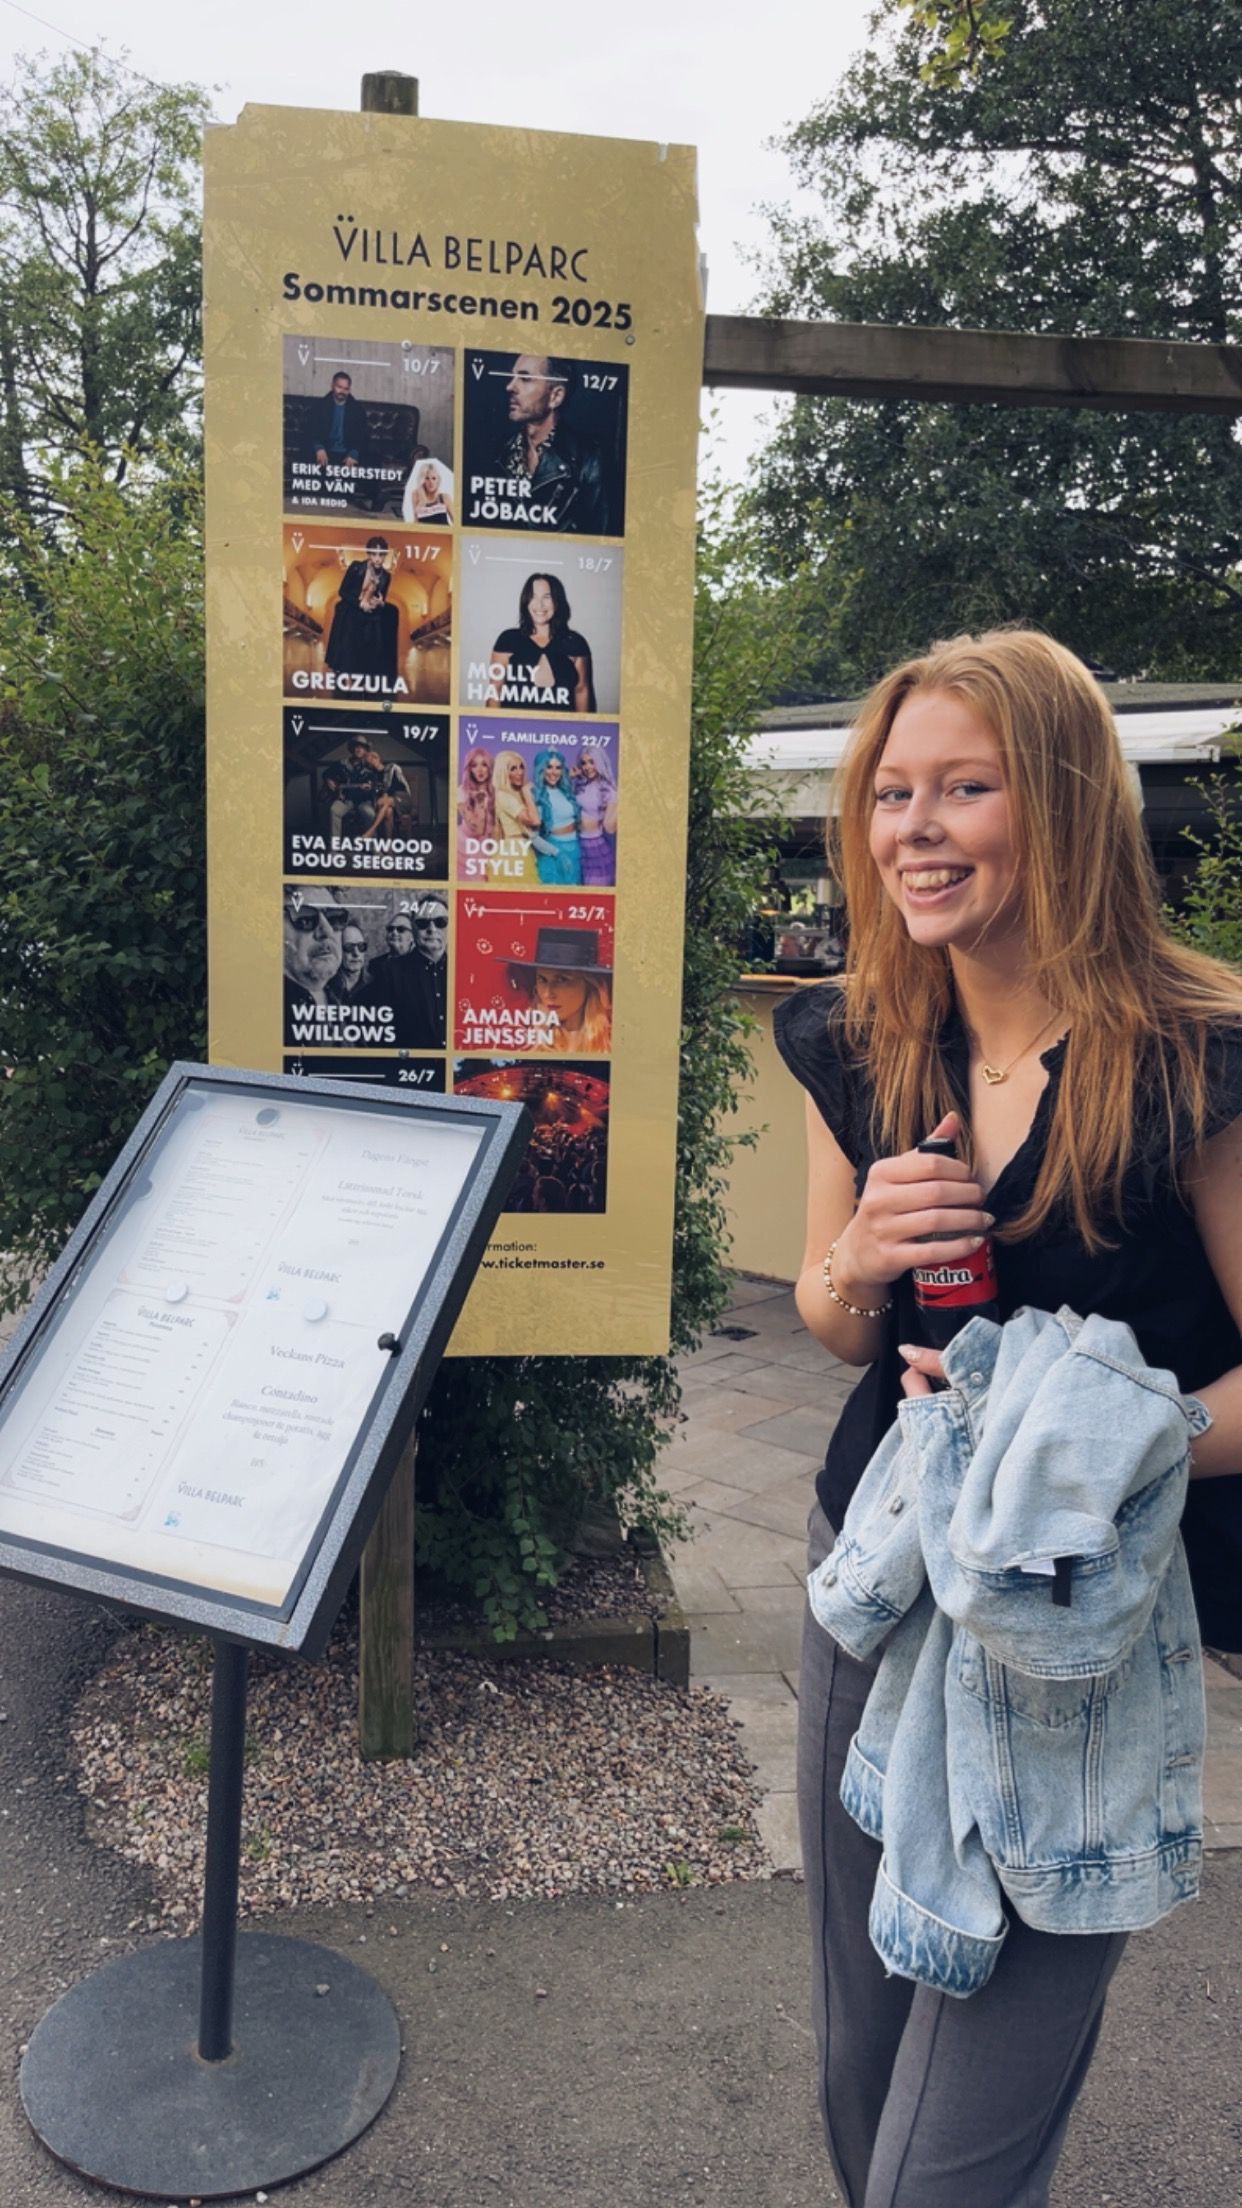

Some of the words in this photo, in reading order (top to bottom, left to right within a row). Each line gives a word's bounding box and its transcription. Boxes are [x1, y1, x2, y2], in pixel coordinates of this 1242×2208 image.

[445, 235, 588, 283] BELPARC
[282, 272, 539, 322] Sommarscenen
[551, 296, 632, 331] 2025
[402, 357, 440, 376] 10/7
[582, 373, 618, 392] 12/7
[292, 463, 322, 476] ERIK
[326, 465, 404, 482] SEGERSTEDT
[292, 479, 322, 492] MED
[325, 479, 355, 494] VÄN
[470, 476, 532, 500] PETER
[301, 497, 318, 506] IDA
[469, 498, 558, 526] JÖBACK
[405, 545, 441, 563] 11/7
[578, 557, 613, 573] 18/7
[467, 662, 539, 683] MOLLY
[292, 670, 409, 695] GRECZULA
[467, 684, 570, 705] HAMMAR
[402, 724, 438, 742] 19/7
[501, 731, 578, 746] FAMILJEDAG
[581, 734, 612, 749] 22/7
[292, 835, 325, 850] EVA
[331, 837, 432, 854] EASTWOOD
[465, 838, 533, 856] DOLLY
[292, 852, 347, 868] DOUG
[352, 854, 426, 872] SEEGERS
[465, 858, 525, 877] STYLE
[399, 901, 437, 916] 24/7
[568, 905, 604, 921] 25/7
[292, 1004, 394, 1023] WEEPING
[463, 1008, 560, 1026] AMANDA
[292, 1024, 396, 1043] WILLOWS
[463, 1028, 555, 1045] JENSSEN
[398, 1069, 435, 1084] 26/7
[488, 1240, 537, 1251] rmation:
[482, 1256, 605, 1269] w.ticketmaster.se
[914, 1267, 972, 1285] andra
[314, 1353, 345, 1369] Pizza
